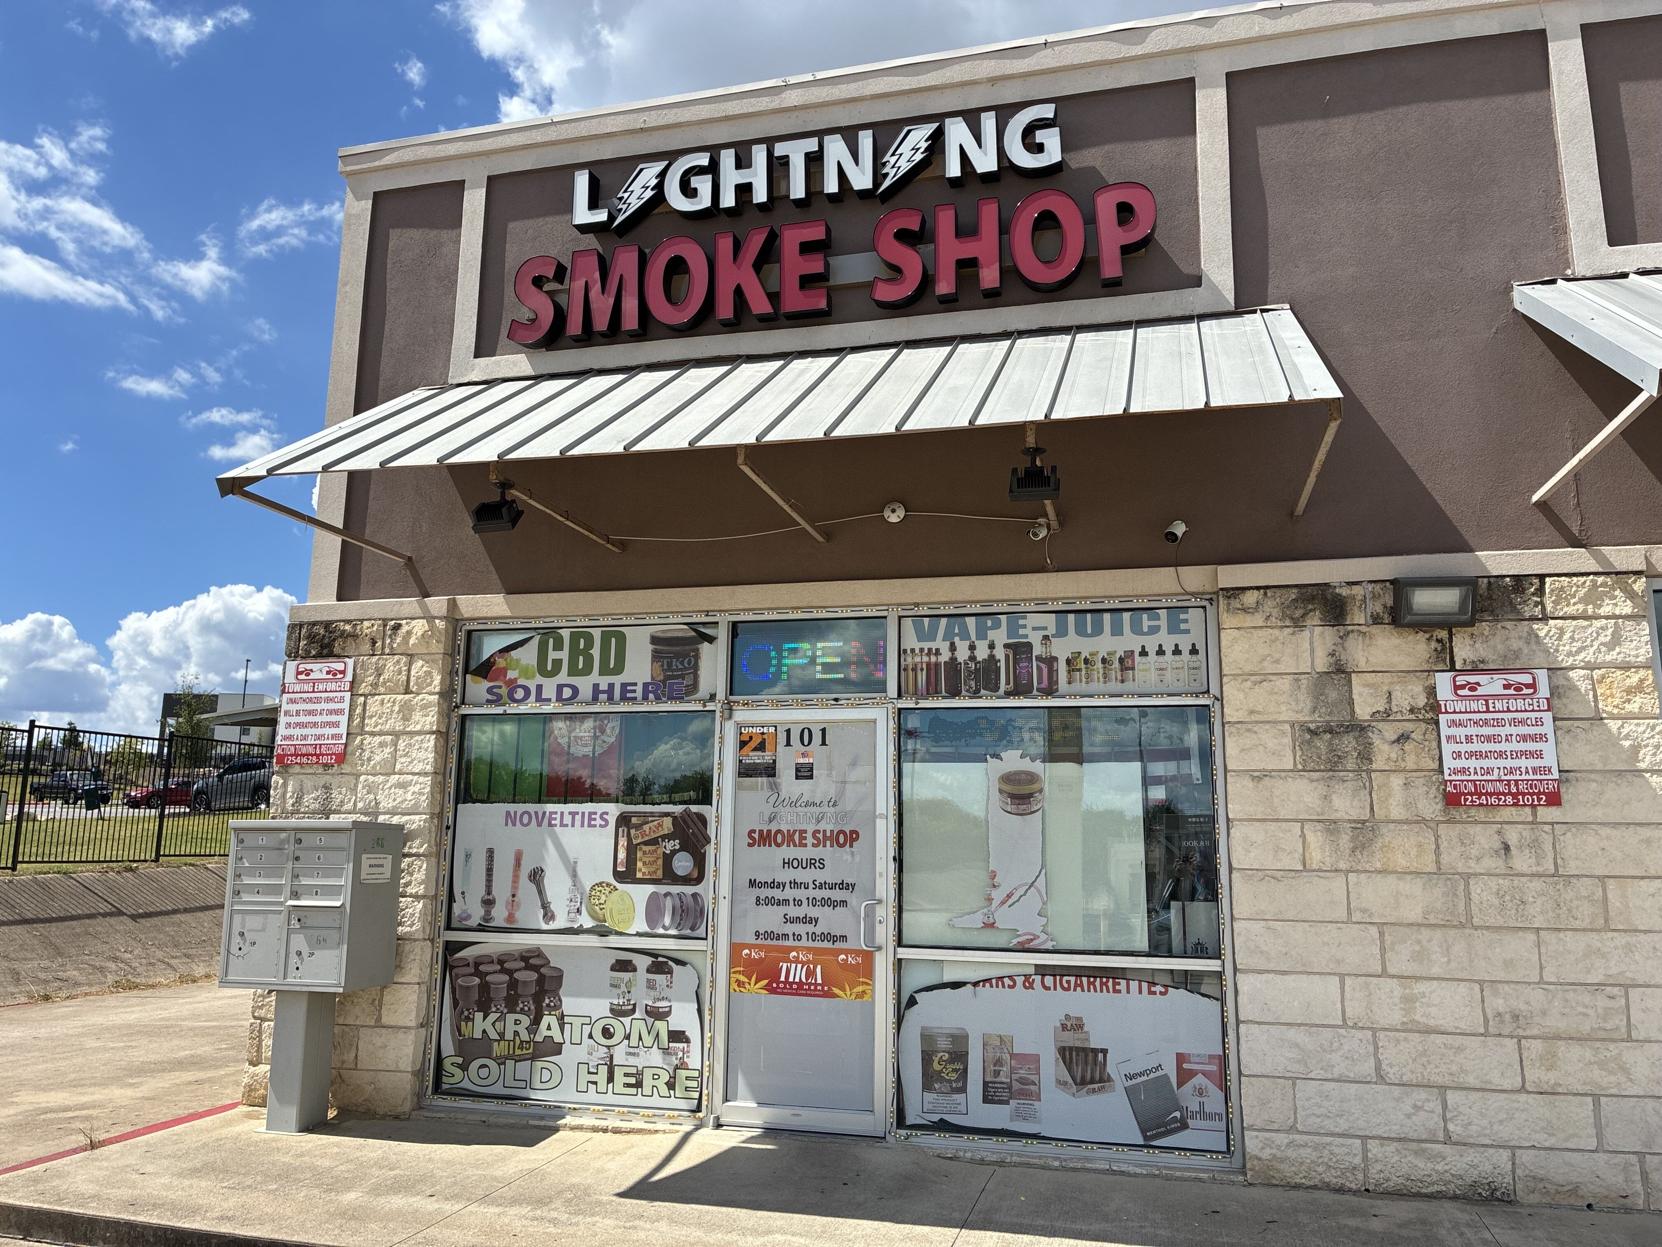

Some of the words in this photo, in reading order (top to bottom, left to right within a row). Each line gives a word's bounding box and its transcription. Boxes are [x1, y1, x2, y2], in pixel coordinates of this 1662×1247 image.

[507, 219, 831, 348] SMOKE
[870, 182, 1158, 309] SHOP
[910, 608, 1192, 643] VAPE-JUICE
[536, 629, 627, 679] CBD
[741, 640, 885, 681] OPEN
[663, 656, 695, 670] TKO
[285, 683, 313, 693] TOWING
[315, 682, 350, 692] ENFORCED
[485, 683, 580, 704] SOLD
[591, 680, 686, 702] HERE
[286, 697, 323, 705] UNAUTHORIZED
[323, 696, 346, 704] VEHICLES
[1439, 700, 1487, 712] TOWING
[1488, 698, 1548, 711] ENFORCED
[284, 709, 294, 718] WILL
[295, 709, 302, 717] BE
[302, 709, 319, 717] TOWED
[326, 708, 346, 716] OWNERS
[284, 722, 293, 730] OR
[293, 721, 320, 730] OPERATORS
[320, 721, 341, 729] EXPENSE
[741, 726, 776, 734] UNDER
[1446, 718, 1507, 729] UNAUTHORIZED
[1508, 717, 1545, 727] VEHICLES
[280, 734, 295, 742] 24HRS
[295, 734, 300, 742] A
[300, 734, 309, 742] DAY
[314, 734, 326, 742] DAYS
[325, 733, 330, 741] A
[330, 733, 344, 741] WEEK
[783, 726, 829, 747] 101
[1445, 735, 1464, 744] WILL
[1465, 735, 1474, 744] BE
[1476, 734, 1503, 744] TOWED
[1504, 734, 1514, 743] AT
[1515, 733, 1549, 743] OWNERS
[277, 746, 295, 754] ACTION
[295, 745, 316, 754] TOWING
[316, 745, 320, 753] &
[320, 745, 345, 753] RECOVERY
[739, 733, 776, 756] 21
[284, 756, 336, 764] (254)628-1012
[1451, 751, 1463, 760] OR
[1464, 750, 1509, 760] OPERATORS
[1510, 750, 1544, 760] EXPENSE
[1448, 767, 1471, 777] 24HRS
[1473, 767, 1479, 776] A
[1480, 767, 1495, 776] DAY
[1496, 767, 1501, 777] 7
[1503, 766, 1523, 776] DAYS
[1524, 766, 1530, 776] A
[1530, 766, 1554, 776] WEEK
[1446, 781, 1475, 793] ACTION
[1476, 781, 1509, 793] TOWING
[1509, 781, 1517, 792] &
[1518, 780, 1559, 792] RECOVERY
[765, 791, 824, 809] Welcome
[826, 796, 840, 808] to
[1461, 795, 1547, 805] (254)628-1012
[504, 809, 610, 829] NOVELTIES
[638, 820, 665, 840] RAW
[747, 828, 808, 848] SMOKE
[811, 829, 860, 848] SHOP
[782, 857, 826, 870] HOURS
[748, 878, 787, 893] Monday
[789, 879, 810, 890] thru
[812, 879, 857, 894] Saturday
[755, 895, 791, 907] 8:00am
[792, 896, 803, 907] to
[806, 896, 849, 910] 10:00pm
[783, 912, 820, 928] Sunday
[754, 930, 791, 942] 9:00am
[792, 931, 803, 942] to
[805, 931, 849, 946] 10:00pm
[751, 948, 766, 960] Koi
[798, 950, 814, 962] Koi
[847, 954, 863, 965] Koi
[1022, 975, 1036, 991] &
[471, 1010, 670, 1050] KRATOM
[1060, 1022, 1086, 1033] RAW
[441, 1054, 564, 1091] SOLD
[575, 1061, 701, 1101] HERE
[1123, 1063, 1165, 1083] Newport
